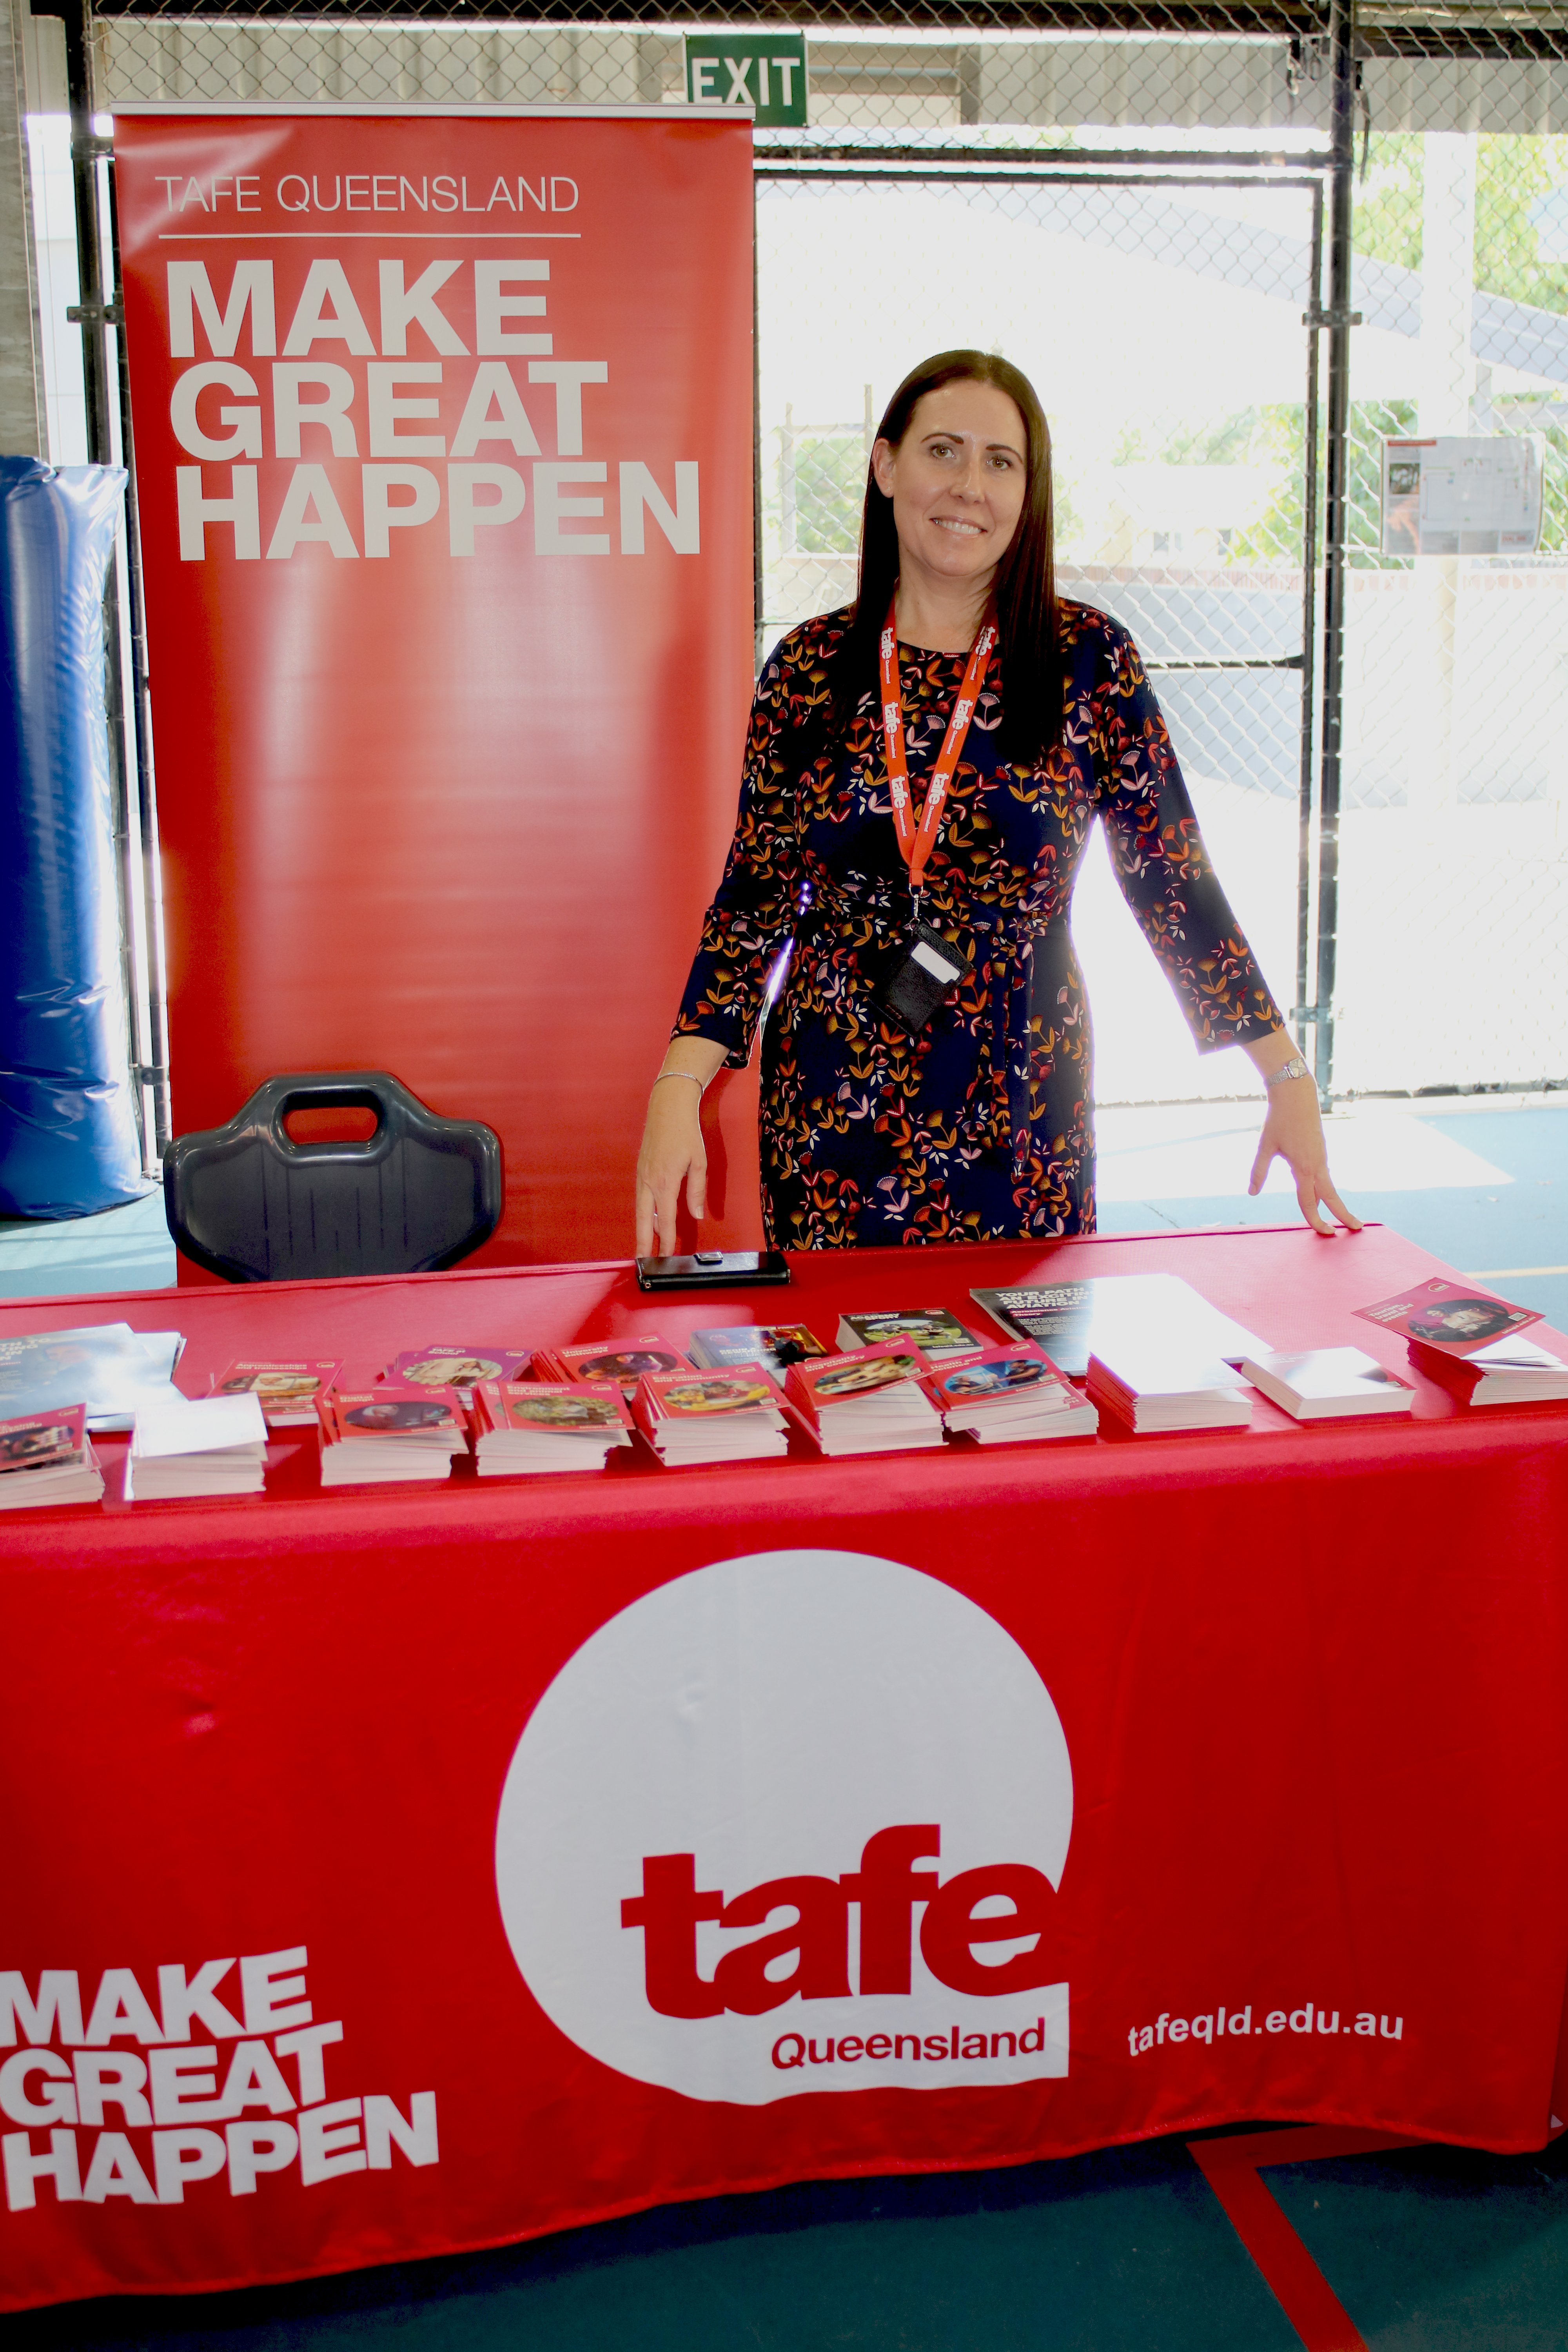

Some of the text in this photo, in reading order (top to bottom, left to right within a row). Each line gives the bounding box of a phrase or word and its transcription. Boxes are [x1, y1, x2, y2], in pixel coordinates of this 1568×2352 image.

[691, 57, 800, 106] EXIT
[155, 175, 579, 213] TAFE QUEENSLAND
[167, 259, 554, 358] MAKE
[170, 361, 608, 461] GREAT
[176, 461, 701, 561] HAPPEN
[881, 627, 893, 659] tafe
[884, 701, 898, 734] tafe
[946, 699, 973, 755] tafe Queensland
[891, 775, 908, 837] tafe Queensland
[924, 773, 949, 832] tafe Queensland
[1003, 1297, 1067, 1305] FUTURE
[1006, 1301, 1080, 1309] AVIATION
[1028, 1291, 1094, 1299] EXCITIN
[1368, 1303, 1403, 1318] Tourism,
[1375, 1303, 1414, 1320] travel and
[1382, 1311, 1408, 1323] events
[621, 1824, 1058, 2019] tafe
[0, 1945, 312, 2047] MAKE
[772, 2017, 1045, 2069] Queensland
[1128, 2002, 1404, 2056] tafeqld.edu.au
[0, 2020, 343, 2127] GREAT
[2, 2091, 439, 2212] HAPPEN
